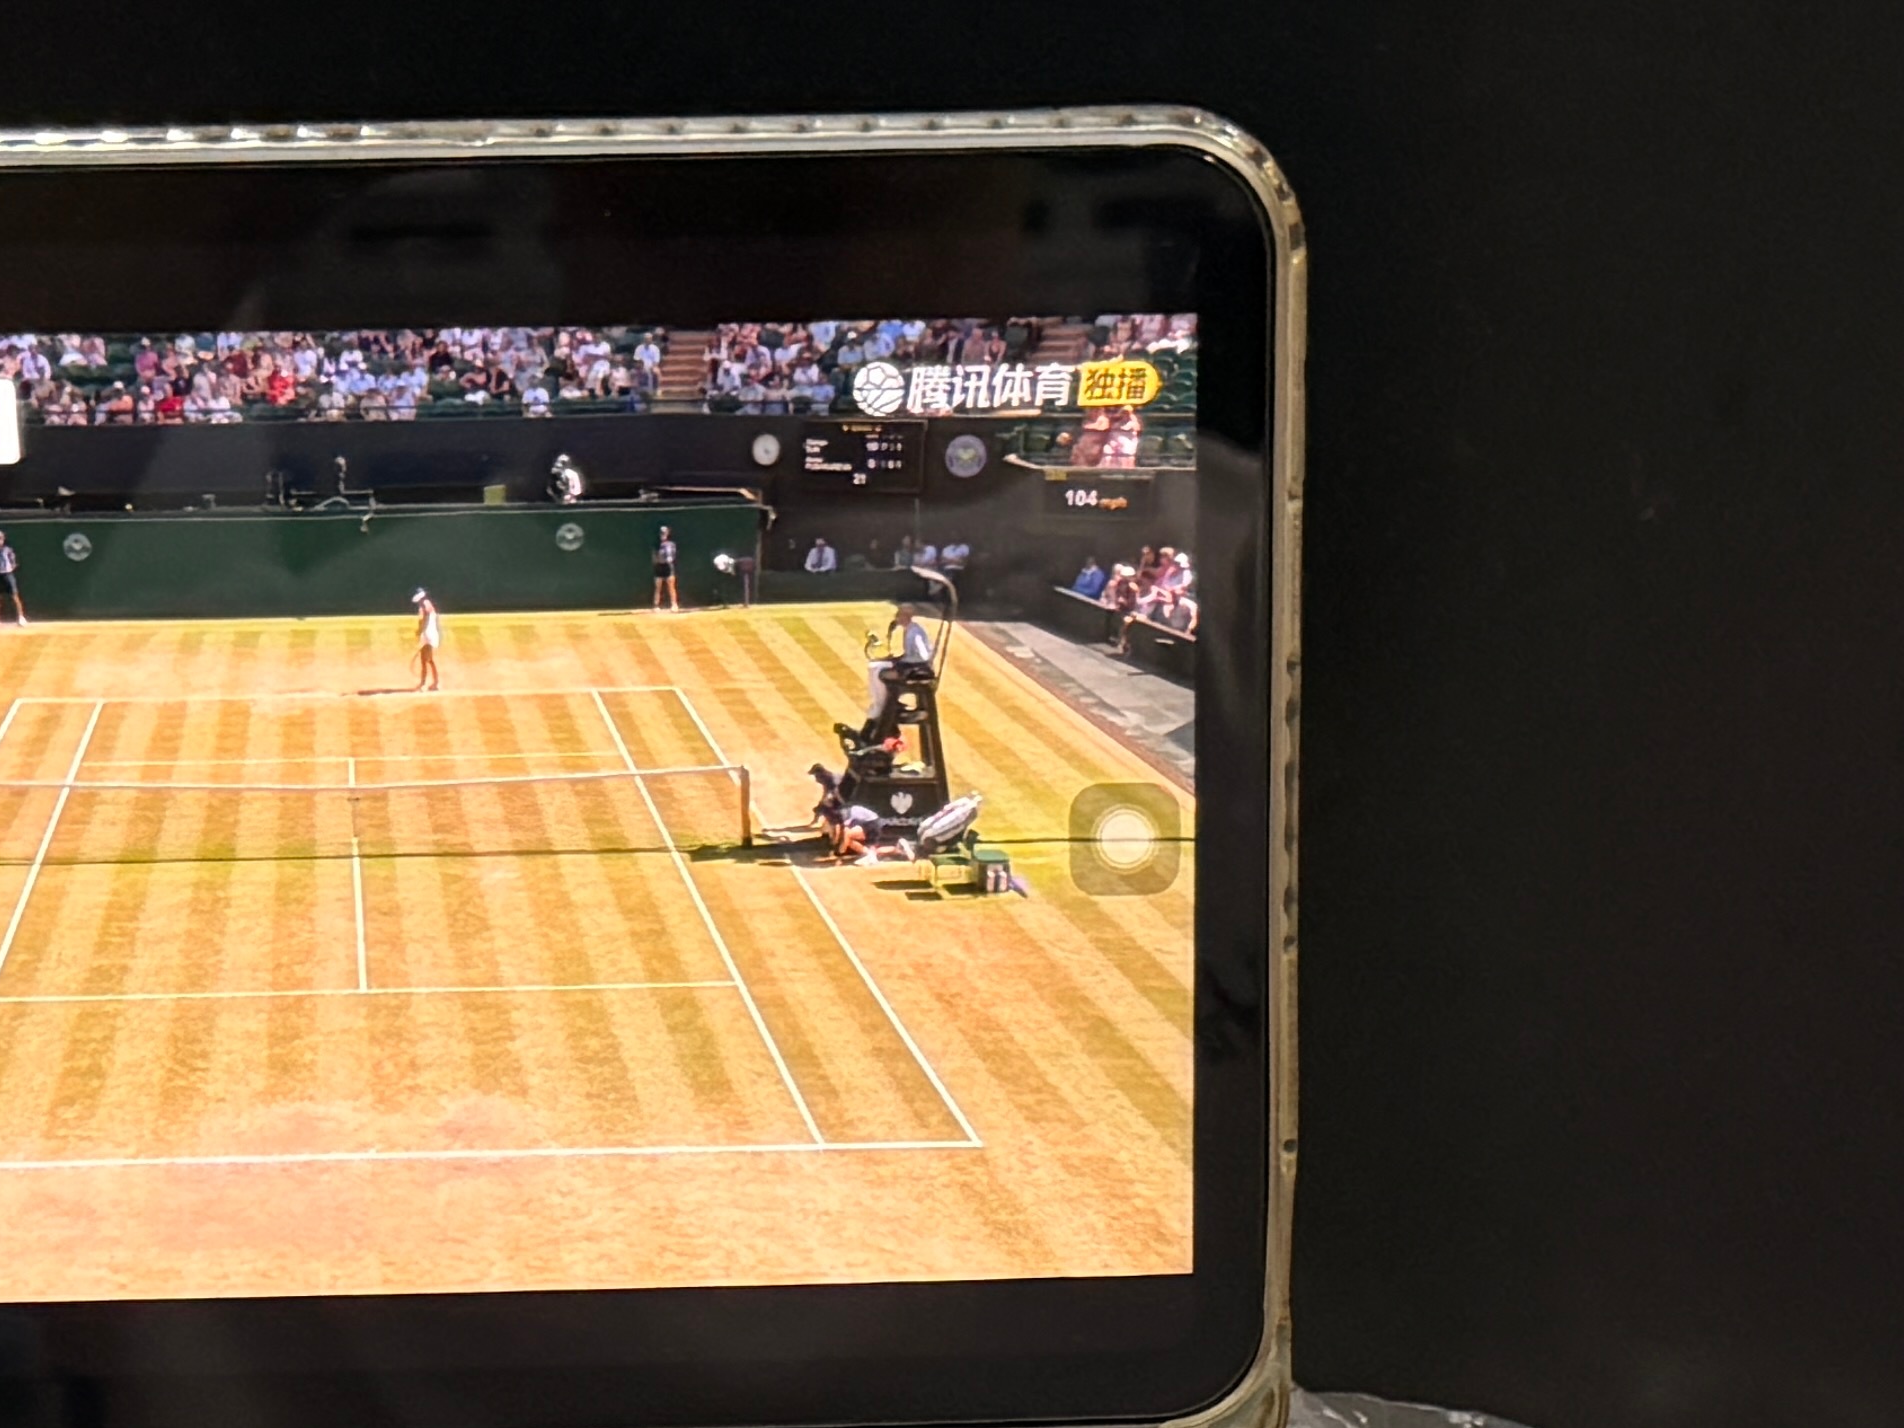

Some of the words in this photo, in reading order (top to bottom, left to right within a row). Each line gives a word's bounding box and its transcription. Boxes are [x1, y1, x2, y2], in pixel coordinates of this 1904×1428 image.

[906, 363, 1073, 410] 腾讯体育
[1084, 367, 1149, 401] 独播
[1064, 489, 1098, 507] 104
